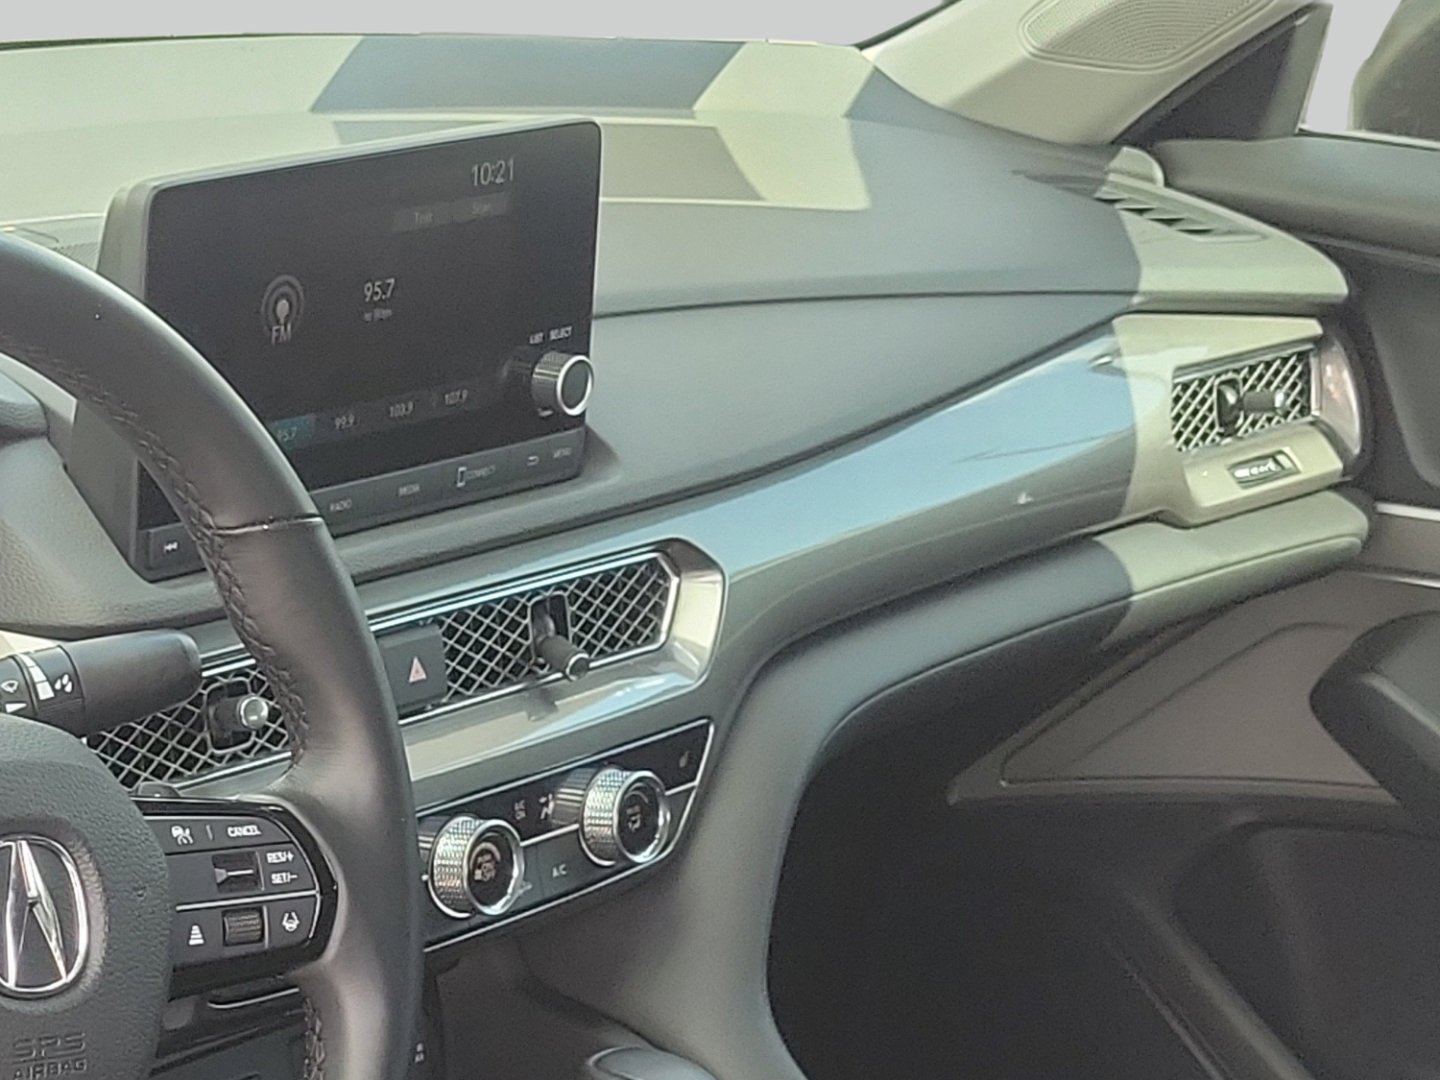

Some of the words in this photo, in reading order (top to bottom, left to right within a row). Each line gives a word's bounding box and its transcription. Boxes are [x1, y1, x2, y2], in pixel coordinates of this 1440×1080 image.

[472, 158, 514, 186] 10:21
[364, 278, 395, 302] 95.7
[272, 323, 291, 345] FM
[12, 1032, 86, 1064] SRS
